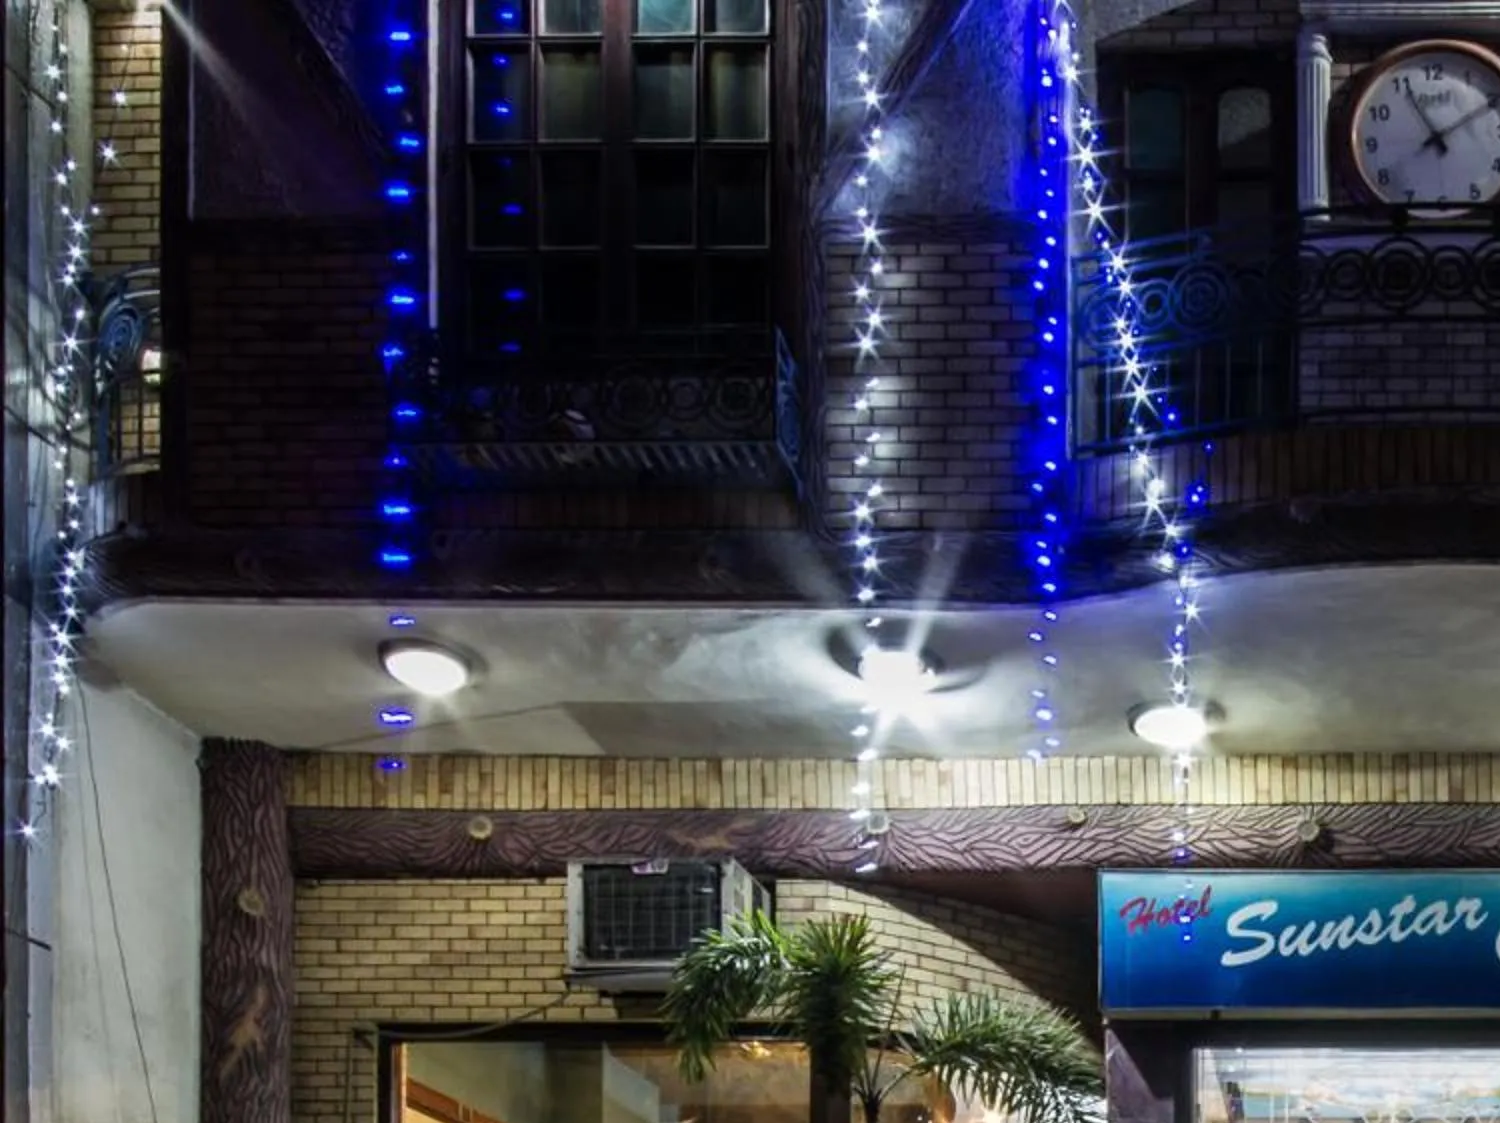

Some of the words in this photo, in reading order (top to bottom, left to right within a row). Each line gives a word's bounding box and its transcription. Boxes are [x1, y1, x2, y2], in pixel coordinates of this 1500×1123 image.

[1422, 63, 1443, 81] 12
[1392, 76, 1410, 93] 11
[1369, 104, 1390, 121] 10
[1365, 136, 1378, 153] 9
[1377, 168, 1389, 186] 8
[1469, 182, 1481, 200] 5
[1120, 884, 1212, 936] Hotel
[1221, 895, 1488, 966] Sunstar
